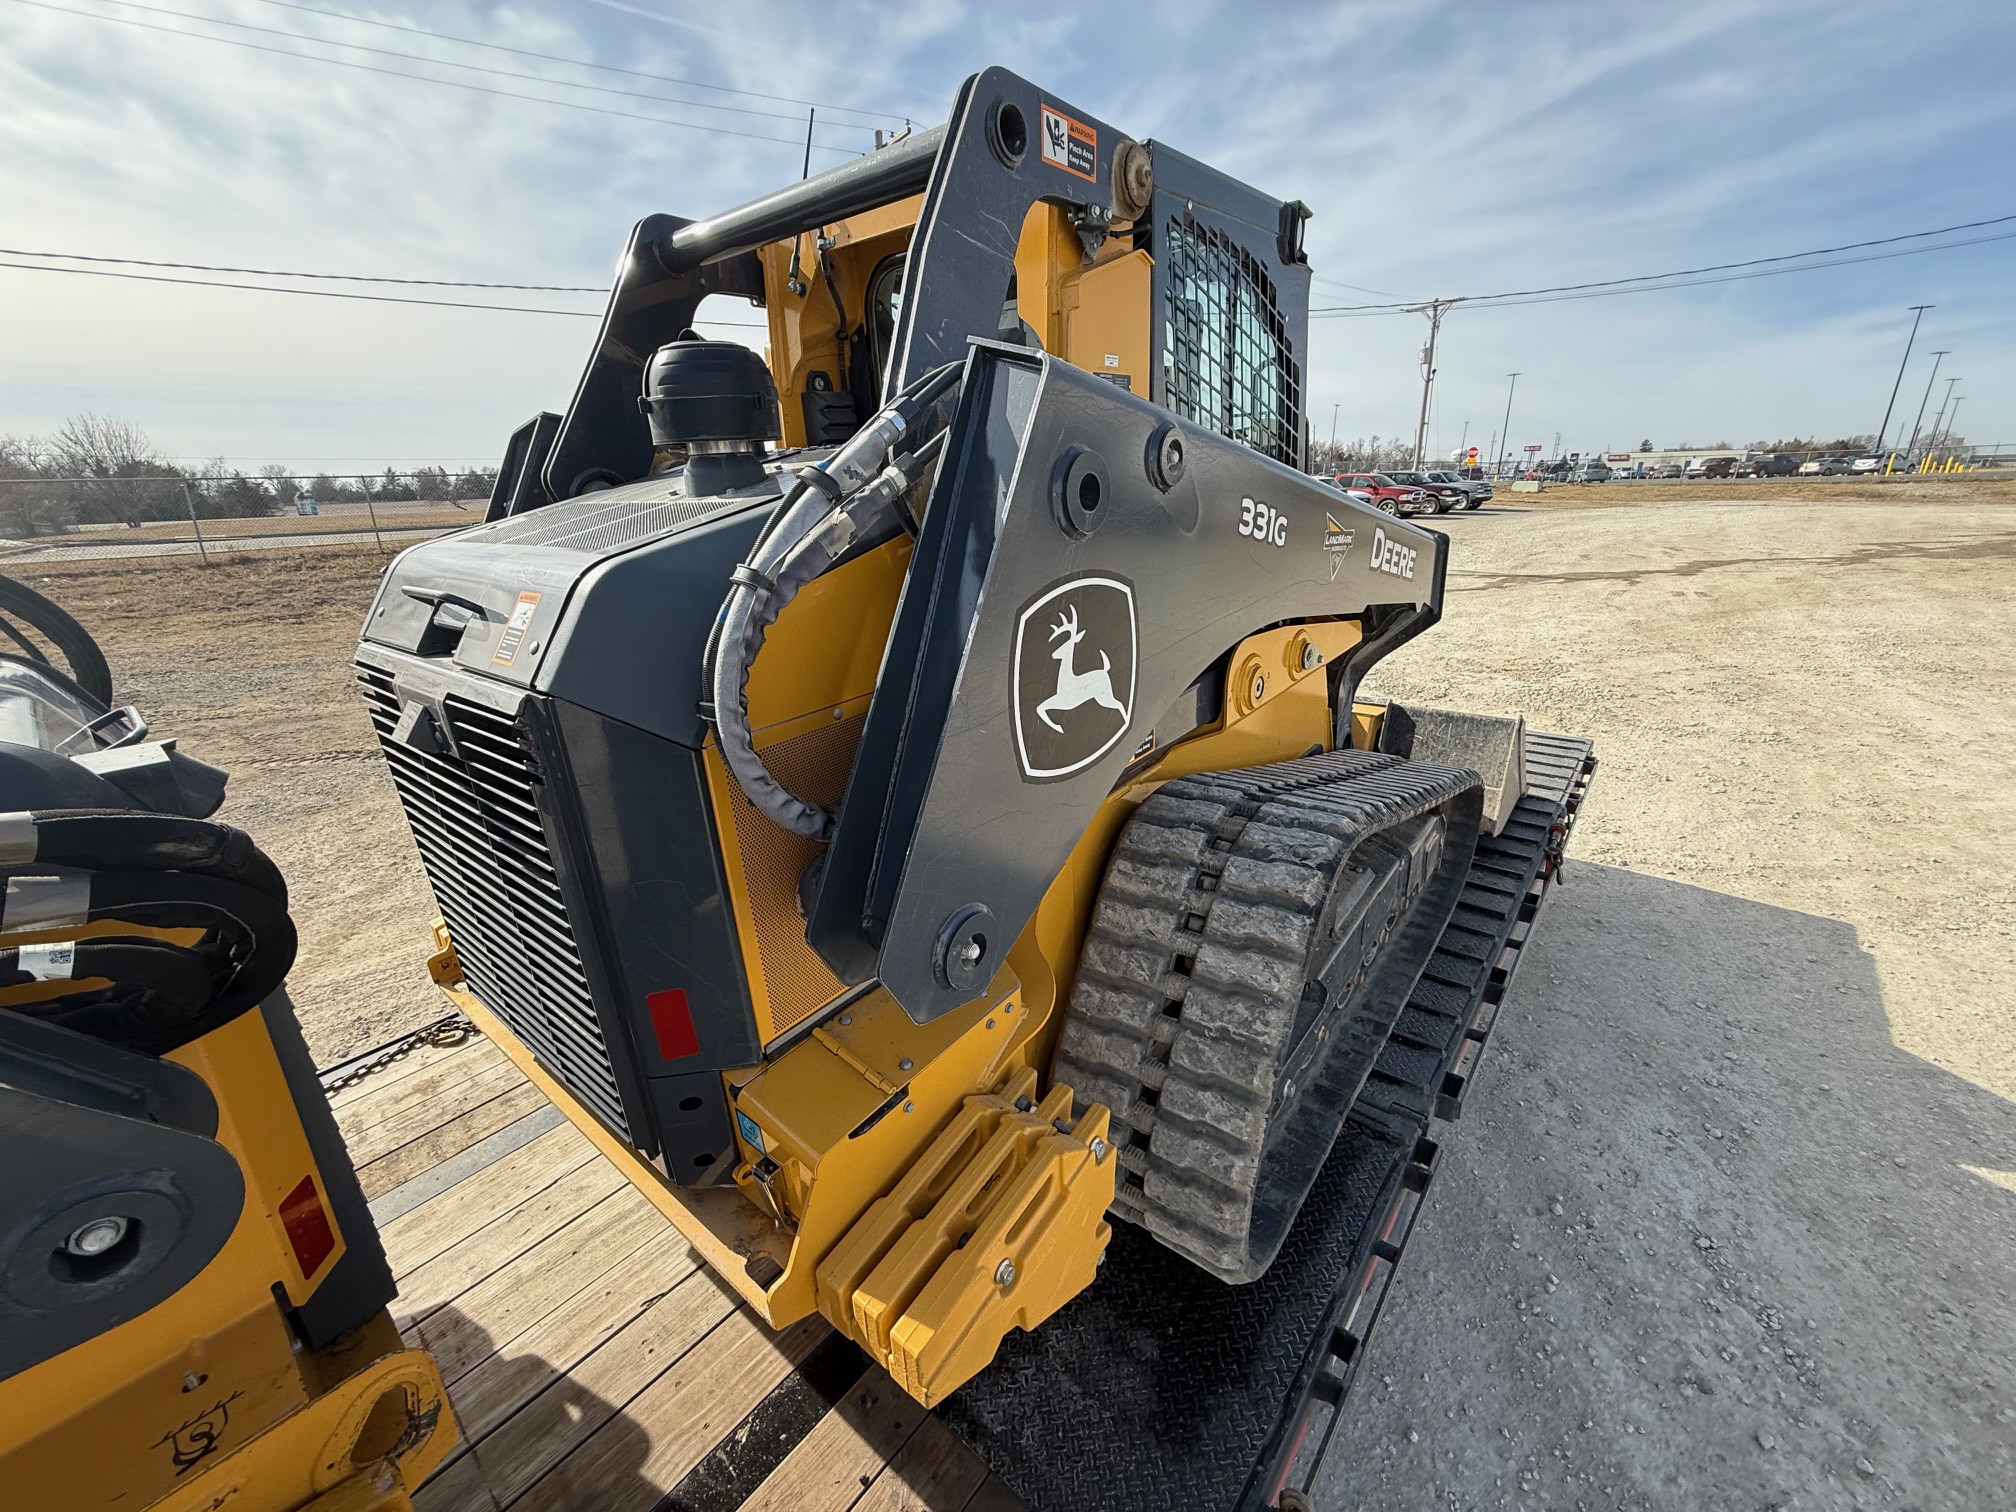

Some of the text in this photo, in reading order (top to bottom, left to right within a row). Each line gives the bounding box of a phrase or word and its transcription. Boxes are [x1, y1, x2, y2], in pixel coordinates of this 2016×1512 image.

[1069, 142, 1094, 161] Pinch Area
[1069, 154, 1079, 166] Keep
[1238, 497, 1288, 547] 331G
[1370, 527, 1417, 579] DEERE
